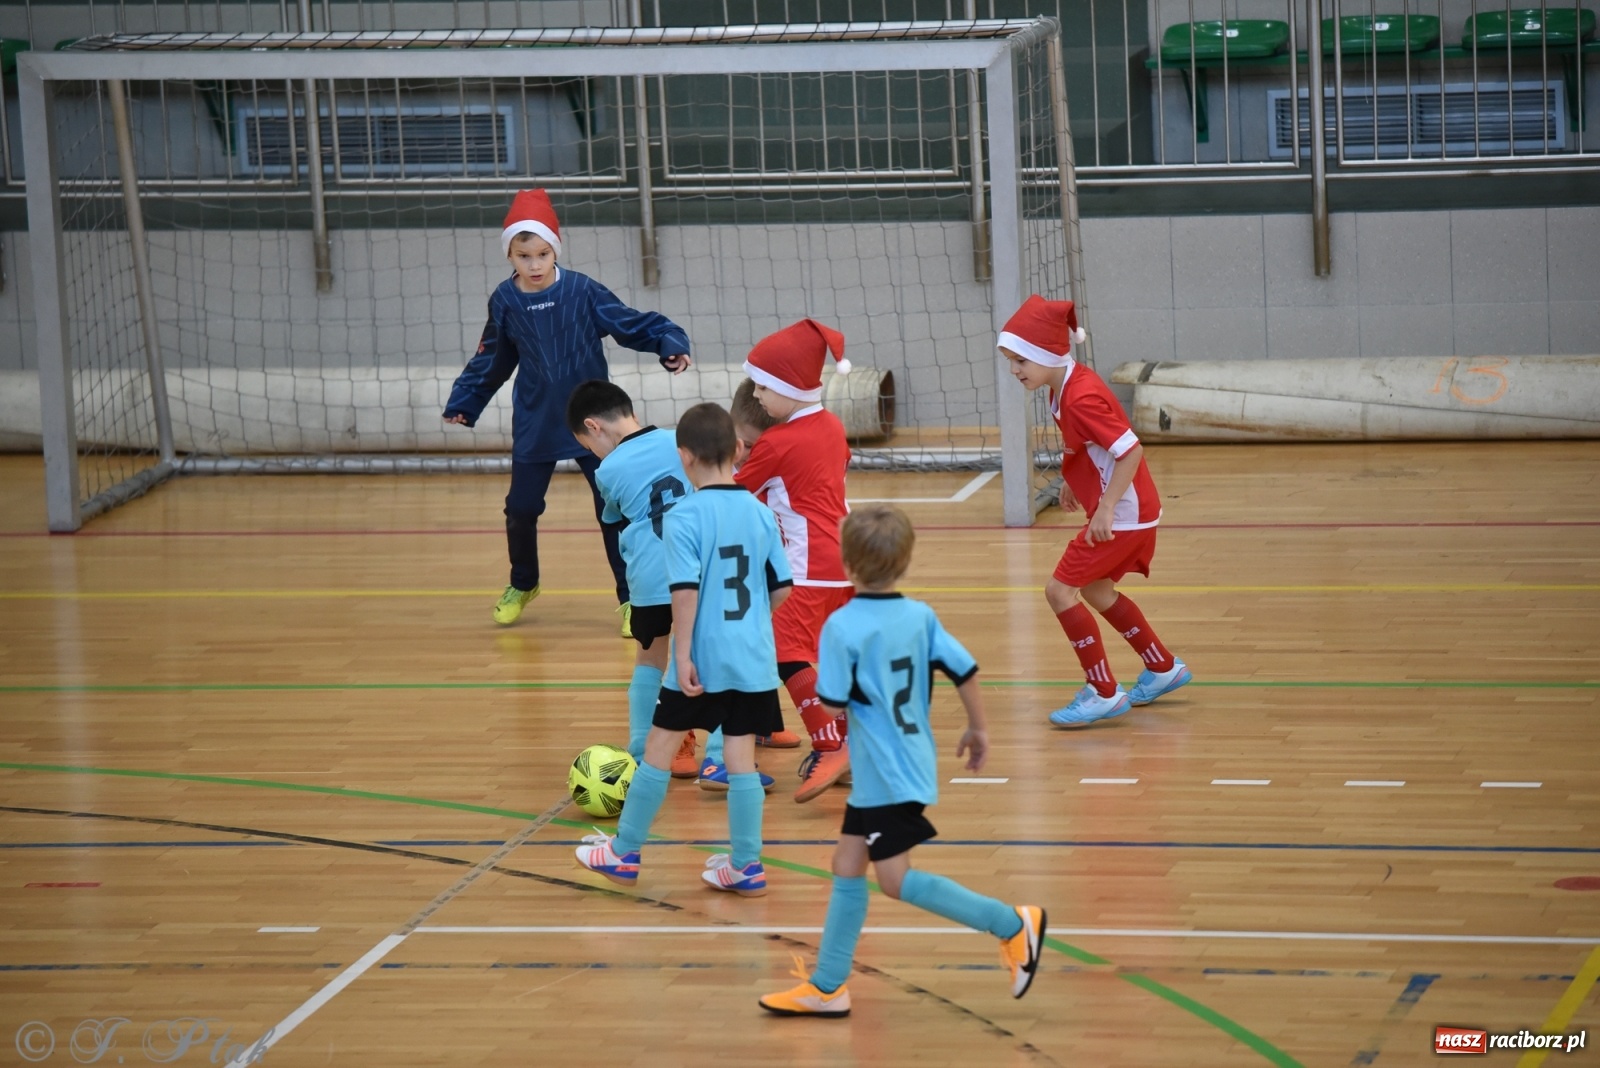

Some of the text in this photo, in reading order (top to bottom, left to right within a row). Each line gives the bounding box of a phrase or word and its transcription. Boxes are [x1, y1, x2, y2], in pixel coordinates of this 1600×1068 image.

[527, 301, 555, 311] regio
[718, 544, 751, 621] 3
[890, 656, 920, 735] 2
